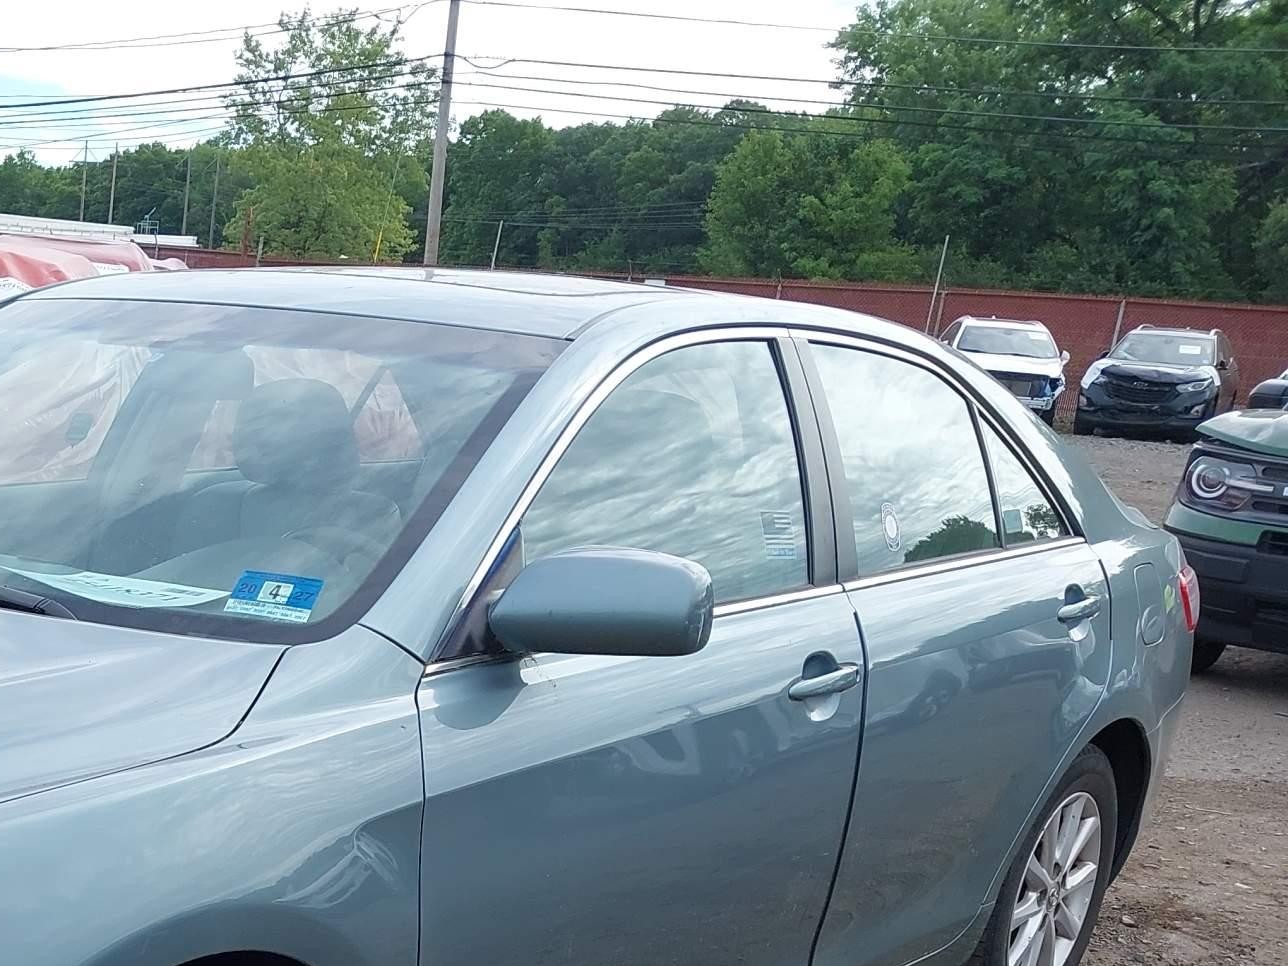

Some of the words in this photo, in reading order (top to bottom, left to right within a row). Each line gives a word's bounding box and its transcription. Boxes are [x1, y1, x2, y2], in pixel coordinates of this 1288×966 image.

[239, 583, 257, 593] 20
[269, 584, 282, 600] 4
[295, 591, 314, 601] 27
